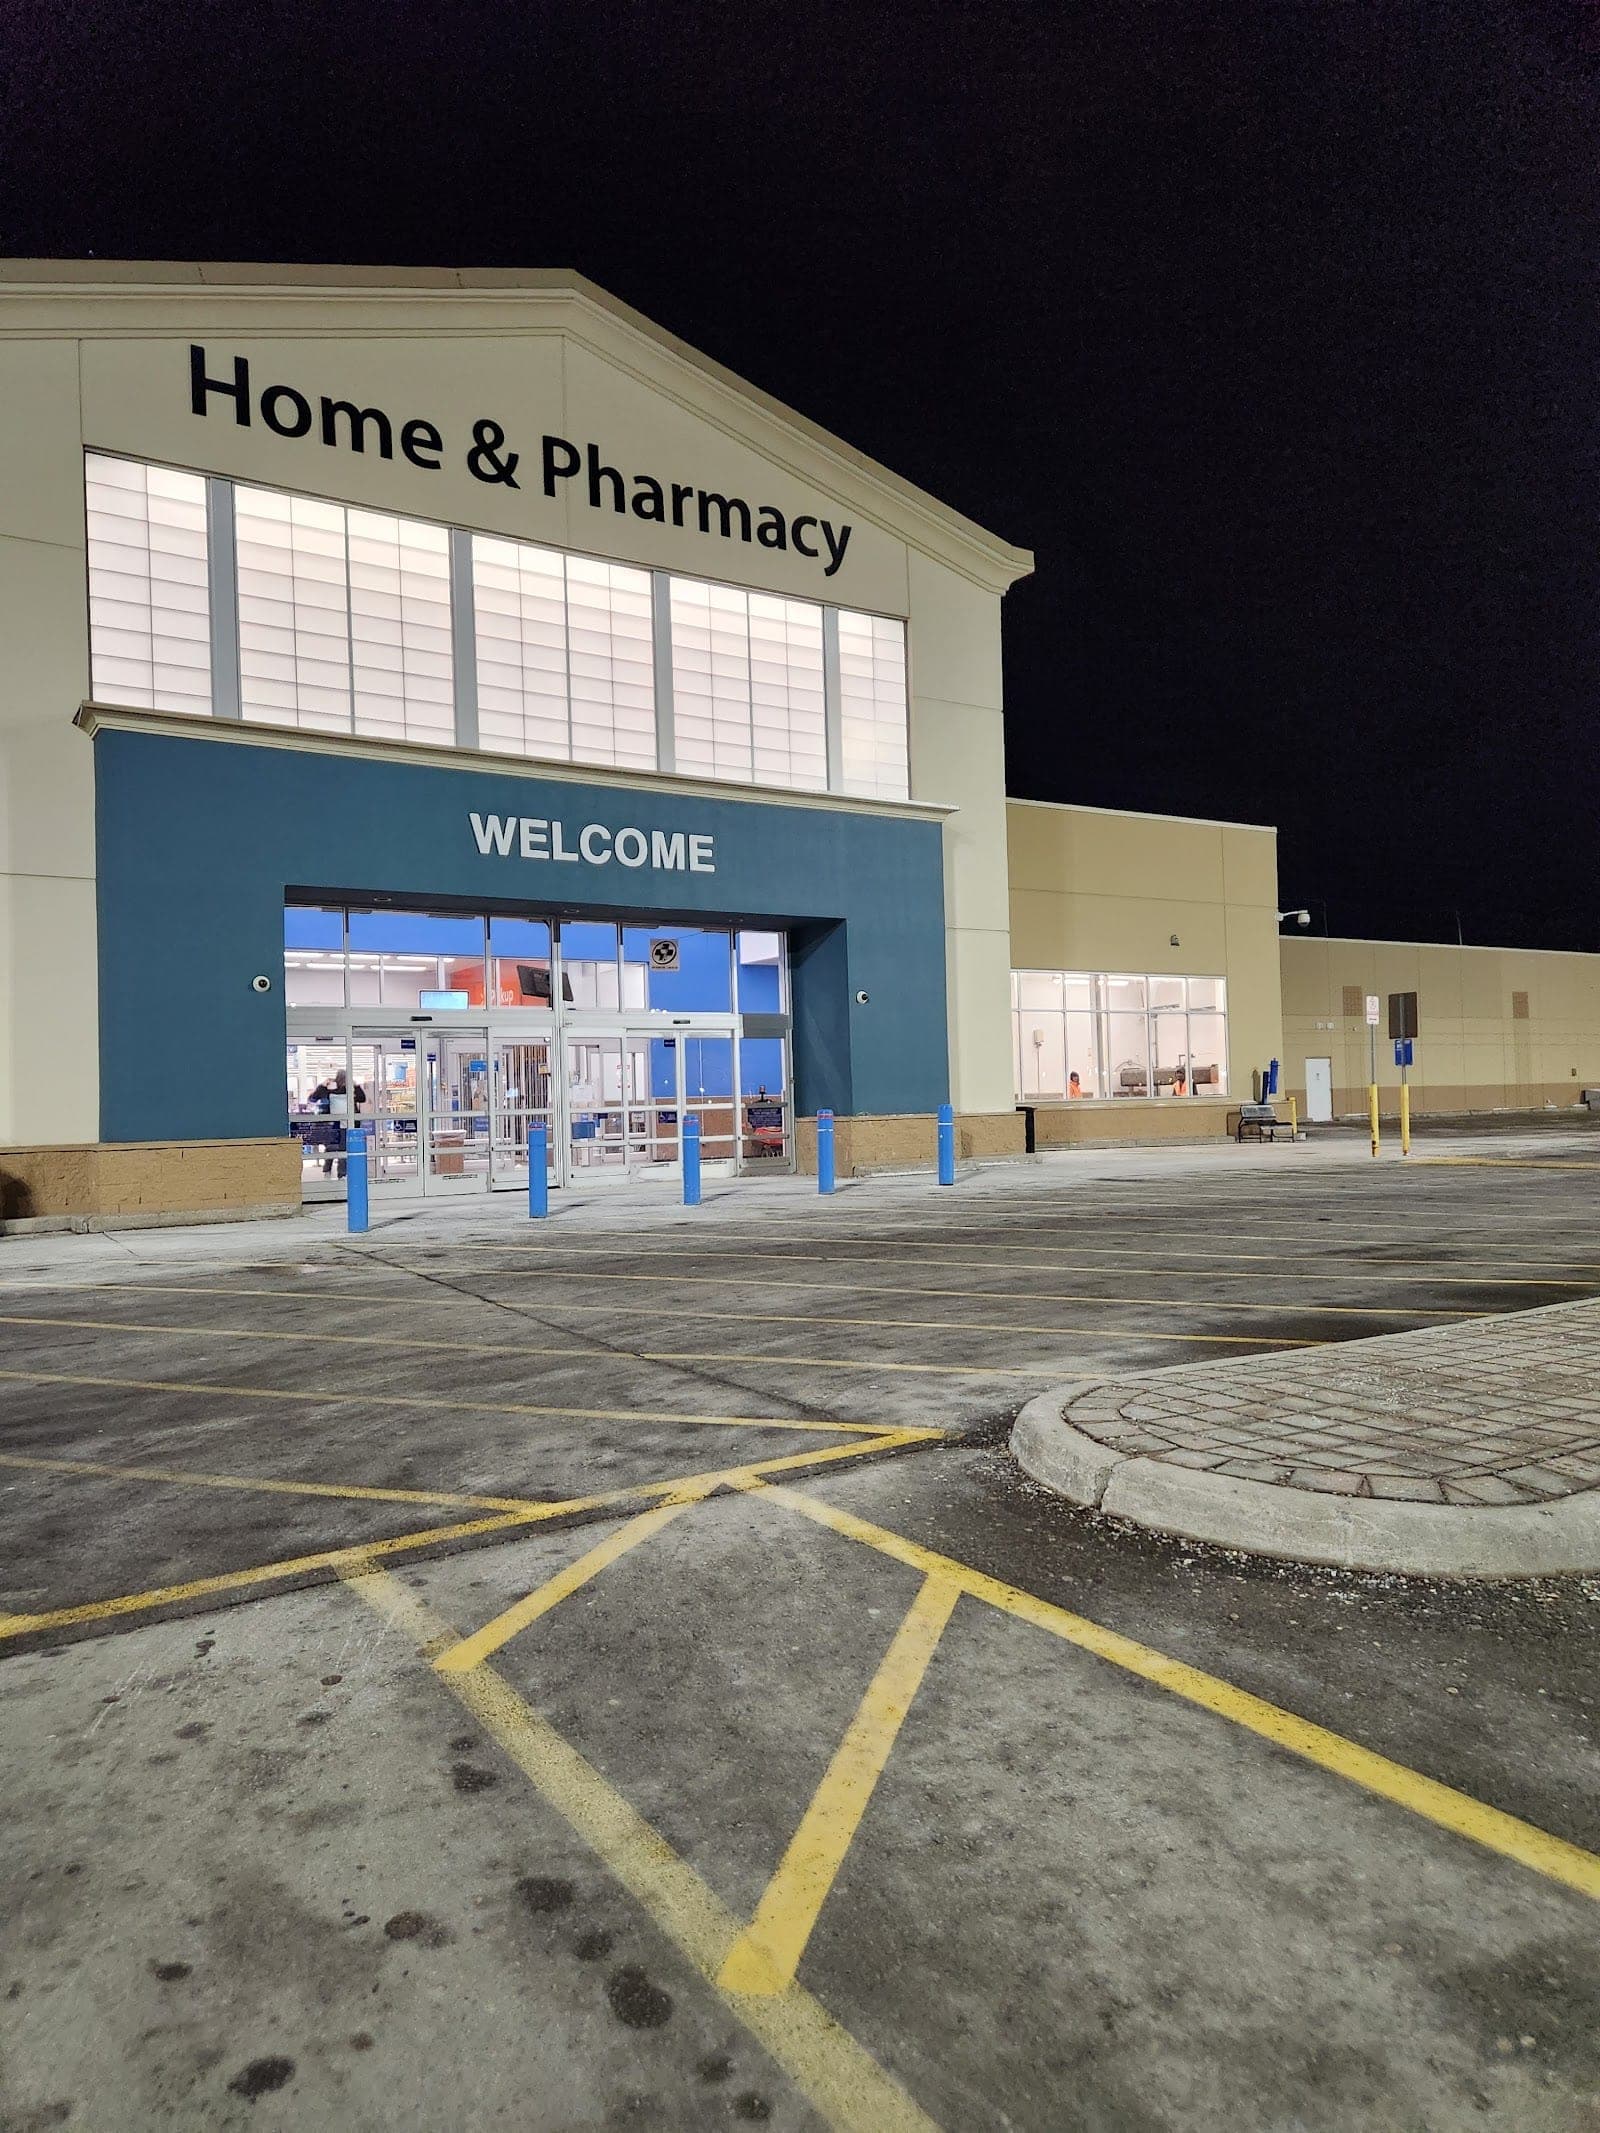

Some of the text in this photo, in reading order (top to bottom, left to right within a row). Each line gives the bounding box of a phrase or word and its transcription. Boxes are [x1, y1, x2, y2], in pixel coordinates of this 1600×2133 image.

[190, 343, 852, 577] Home & Pharmacy
[468, 811, 717, 874] WELCOME
[489, 986, 514, 1009] Pkup
